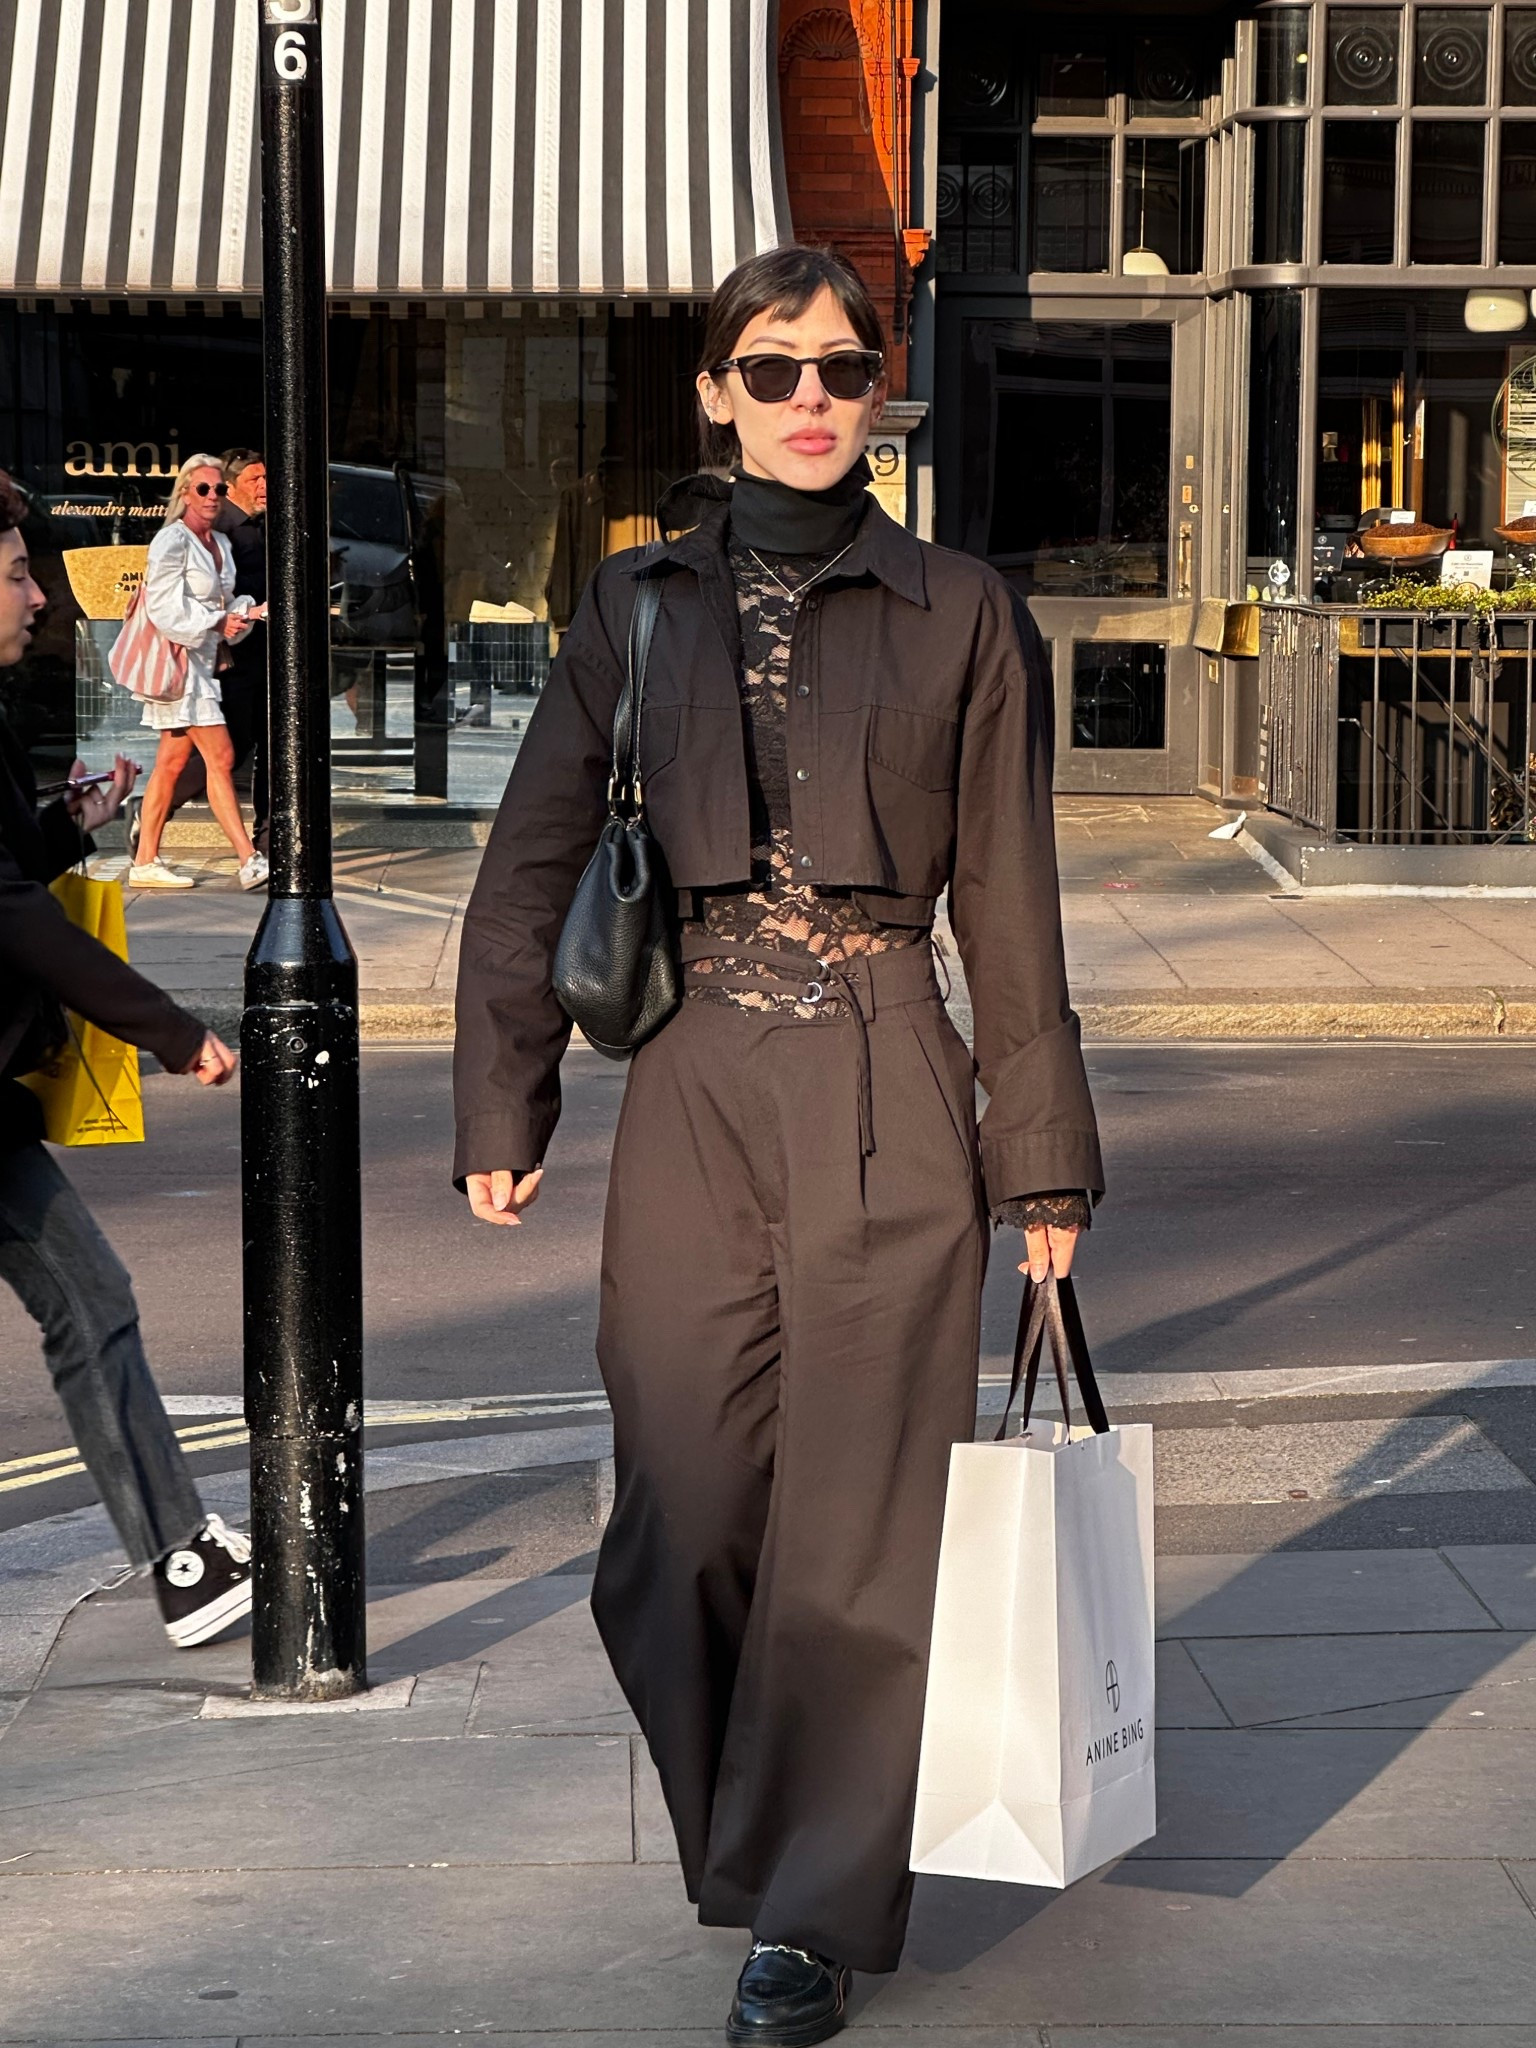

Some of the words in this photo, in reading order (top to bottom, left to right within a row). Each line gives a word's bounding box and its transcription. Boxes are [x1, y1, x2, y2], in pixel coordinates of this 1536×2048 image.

[274, 31, 307, 80] 6
[65, 428, 180, 477] ami
[864, 443, 899, 476] 9
[51, 500, 125, 516] alexandre
[1086, 1732, 1119, 1766] ANINE
[1122, 1718, 1144, 1749] BING
